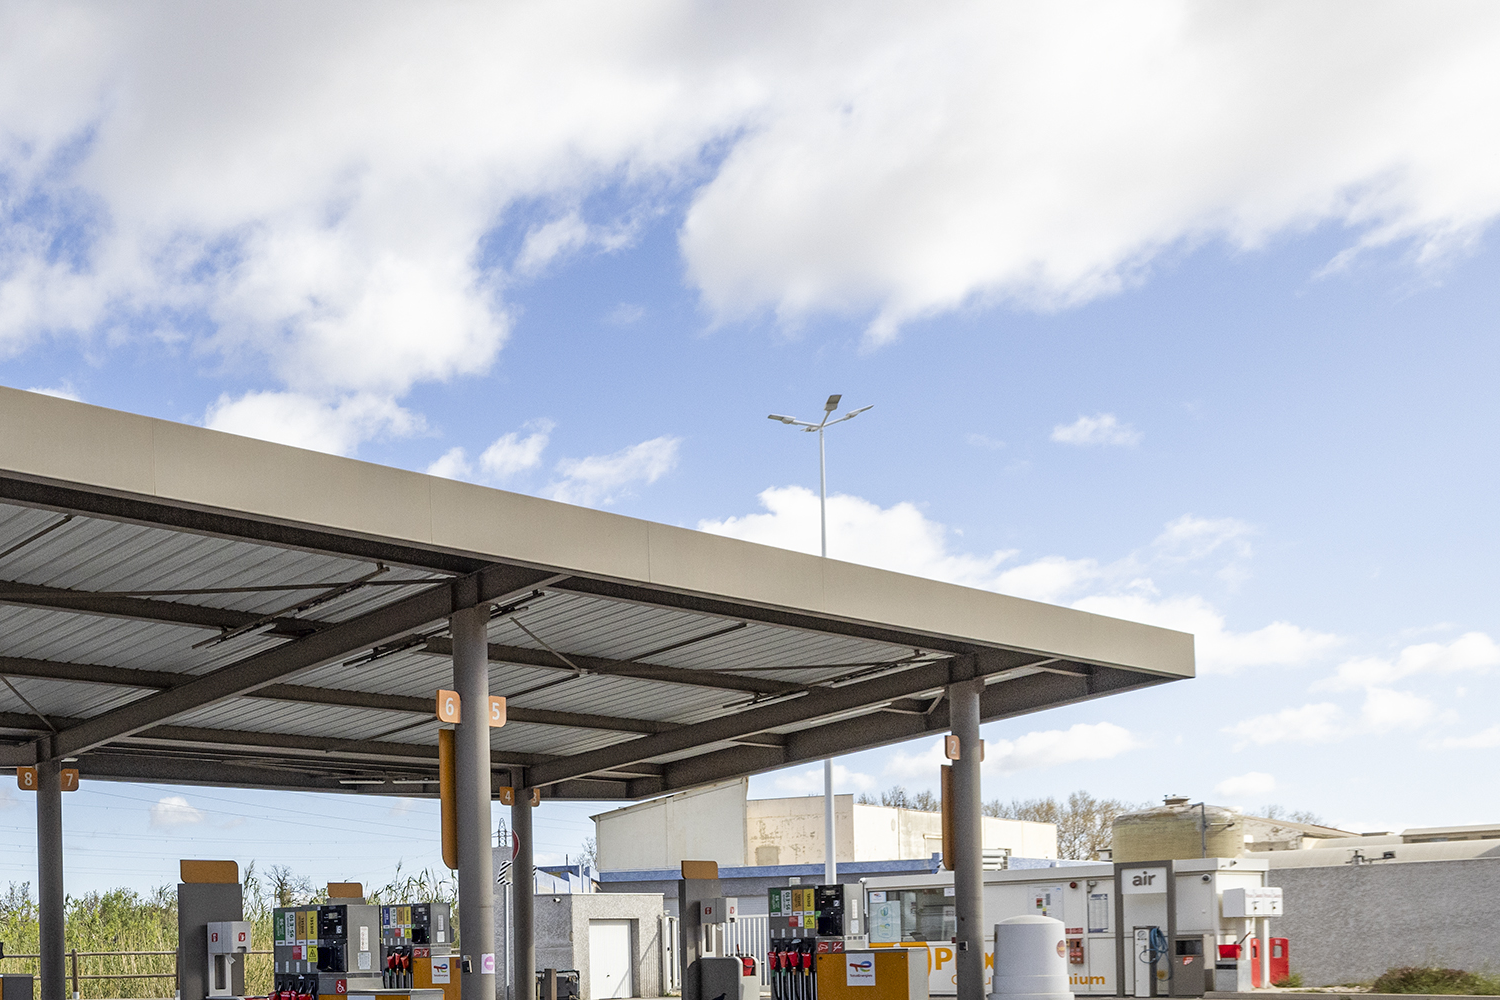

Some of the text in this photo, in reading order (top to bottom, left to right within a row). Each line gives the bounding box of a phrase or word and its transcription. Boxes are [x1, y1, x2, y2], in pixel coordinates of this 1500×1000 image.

[445, 697, 454, 716] 6
[492, 702, 500, 720] 5
[950, 740, 956, 755] 2
[24, 771, 33, 786] 8
[65, 773, 74, 787] 7
[504, 790, 511, 801] 4
[1132, 870, 1156, 887] air
[337, 925, 342, 934] 6
